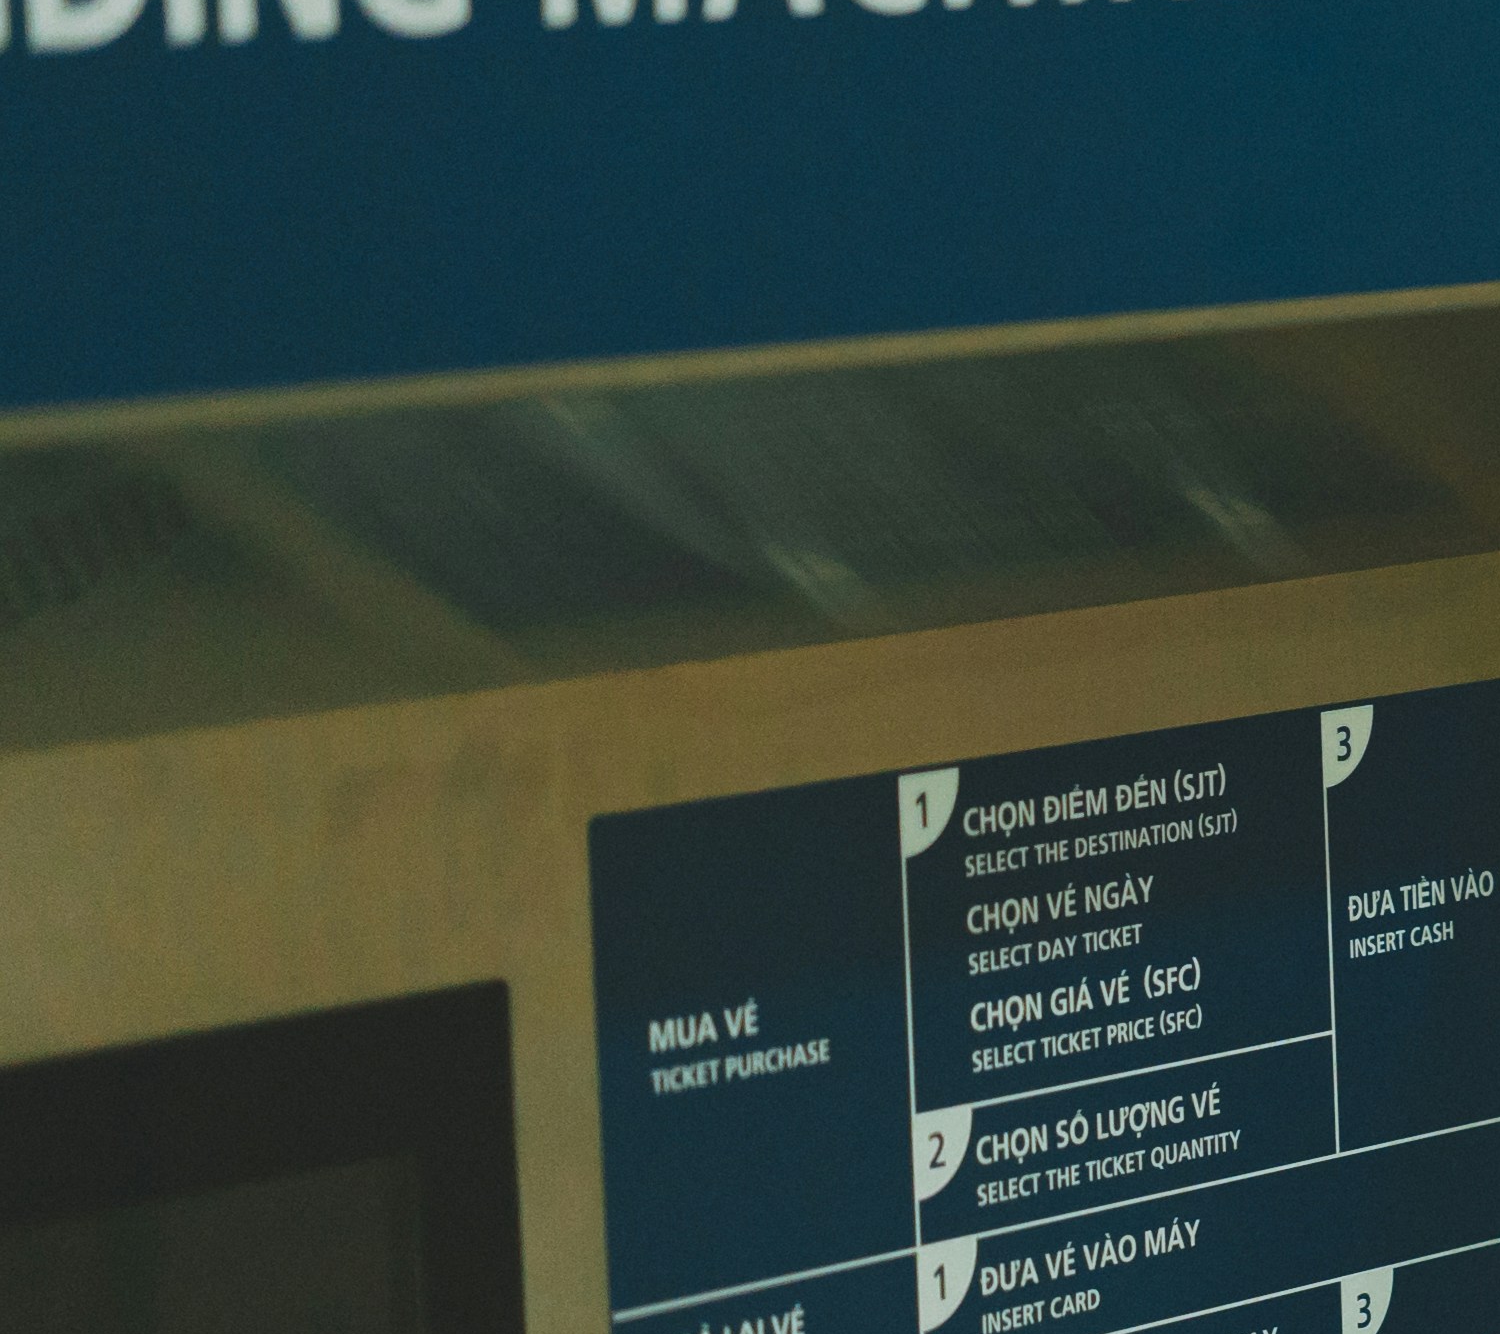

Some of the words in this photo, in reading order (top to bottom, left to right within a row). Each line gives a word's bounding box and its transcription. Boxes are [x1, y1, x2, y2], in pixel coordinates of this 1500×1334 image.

[1336, 725, 1352, 762] 3
[915, 791, 928, 828] 1
[963, 799, 1035, 838] CHỌN
[1043, 784, 1108, 825] ĐIỂM
[1116, 774, 1167, 812] ĐẾN
[1174, 763, 1226, 808] (SJT)
[965, 846, 1029, 878] SELECT
[1034, 841, 1069, 865] THE
[1075, 820, 1193, 859] DESTINATION
[1198, 808, 1238, 838] (SJT)
[967, 895, 1039, 935] CHỌN
[1047, 882, 1077, 920] VÉ
[1085, 873, 1153, 914] NGÀY
[1348, 889, 1395, 922] ĐƯA
[1400, 875, 1446, 912] TIỀN
[1450, 867, 1495, 902] VÀO
[968, 943, 1032, 976] SELECT
[1038, 935, 1077, 963] DAY
[1082, 923, 1143, 955] TICKET
[1349, 929, 1406, 959] INSERT
[1410, 920, 1454, 947] CASH
[970, 992, 1042, 1032] CHỌN
[1050, 976, 1093, 1017] GIÁ
[1099, 969, 1130, 1007] VÉ
[1144, 956, 1201, 1000] (SFC)
[648, 1010, 718, 1054] MUA
[723, 996, 760, 1039] VÉ
[972, 1040, 1036, 1073] SELECT
[1040, 1027, 1102, 1058] TICKET
[1106, 1016, 1155, 1047] PRICE
[1159, 1003, 1202, 1035] (SFC)
[651, 1057, 721, 1097] TICKET
[724, 1037, 831, 1082] PURCHASE
[928, 1131, 946, 1169] 2
[976, 1123, 1048, 1164] CHỌN
[1056, 1108, 1088, 1148] SỐ
[1097, 1095, 1185, 1139] LƯỢNG
[1192, 1081, 1221, 1119] VÉ
[977, 1172, 1042, 1207] SELECT
[1046, 1164, 1081, 1191] THE
[1085, 1149, 1145, 1182] TICKET
[1150, 1129, 1241, 1169] QUANTITY
[933, 1264, 946, 1301] 1
[980, 1257, 1039, 1295] ĐƯA
[1045, 1242, 1075, 1280] VÉ
[1083, 1232, 1136, 1269] VÀO
[1144, 1217, 1200, 1258] MÁY
[1050, 1288, 1100, 1318] CARD
[1356, 1292, 1372, 1329] 3
